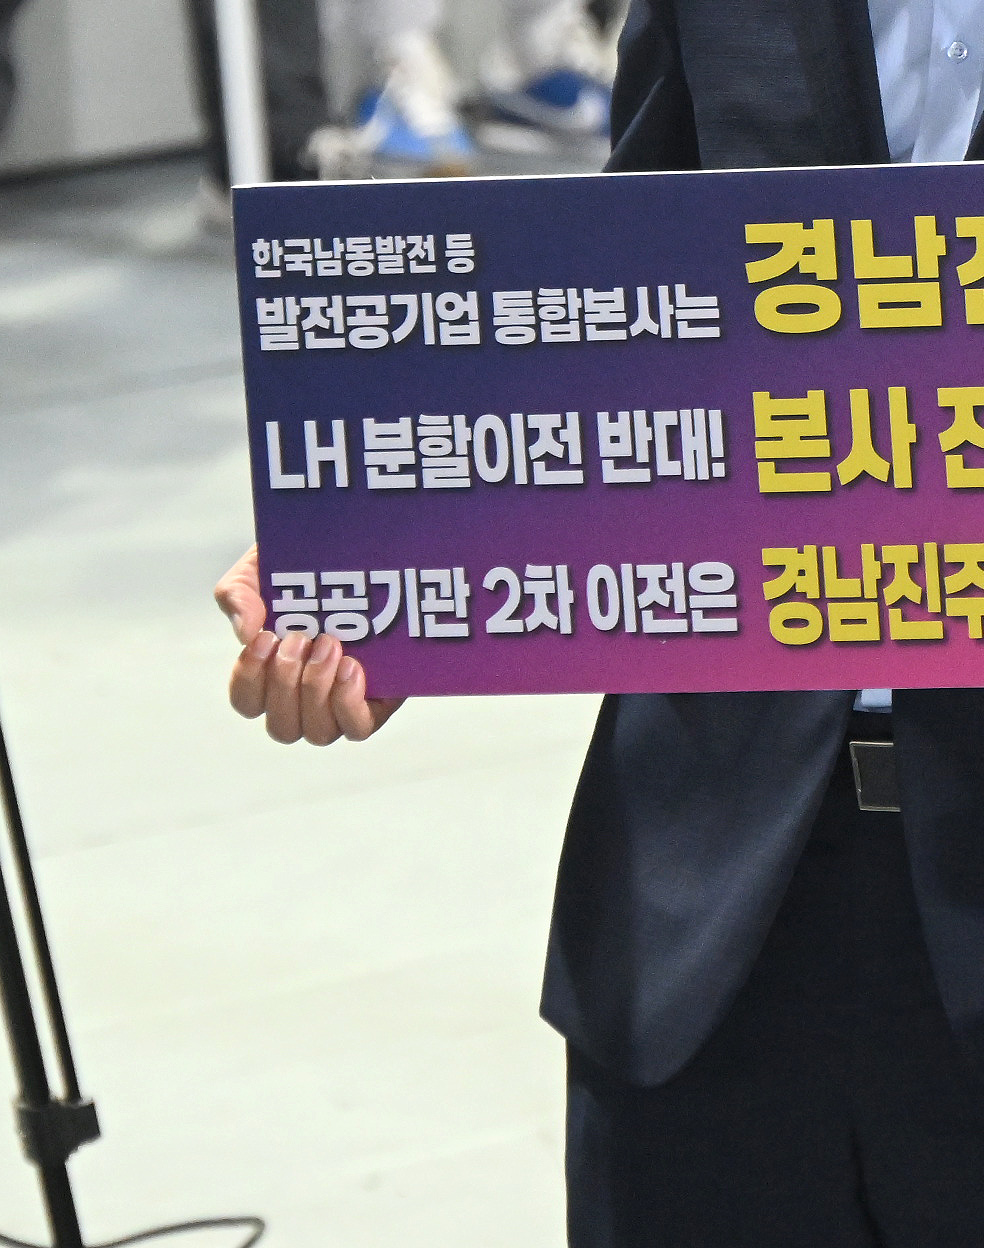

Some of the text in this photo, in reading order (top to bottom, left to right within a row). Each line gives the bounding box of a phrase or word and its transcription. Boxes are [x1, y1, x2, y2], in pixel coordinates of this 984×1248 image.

[252, 234, 475, 277] 한국남동발전 등
[256, 291, 480, 350] 발전공기업
[493, 284, 720, 344] 통합본사는
[266, 420, 348, 488] LH
[363, 412, 583, 489] 분할이전
[597, 409, 725, 483] 반대!
[754, 387, 916, 492] 본사
[271, 567, 470, 642] 공공기관
[483, 564, 574, 634] 2차
[587, 562, 737, 633] 이전은
